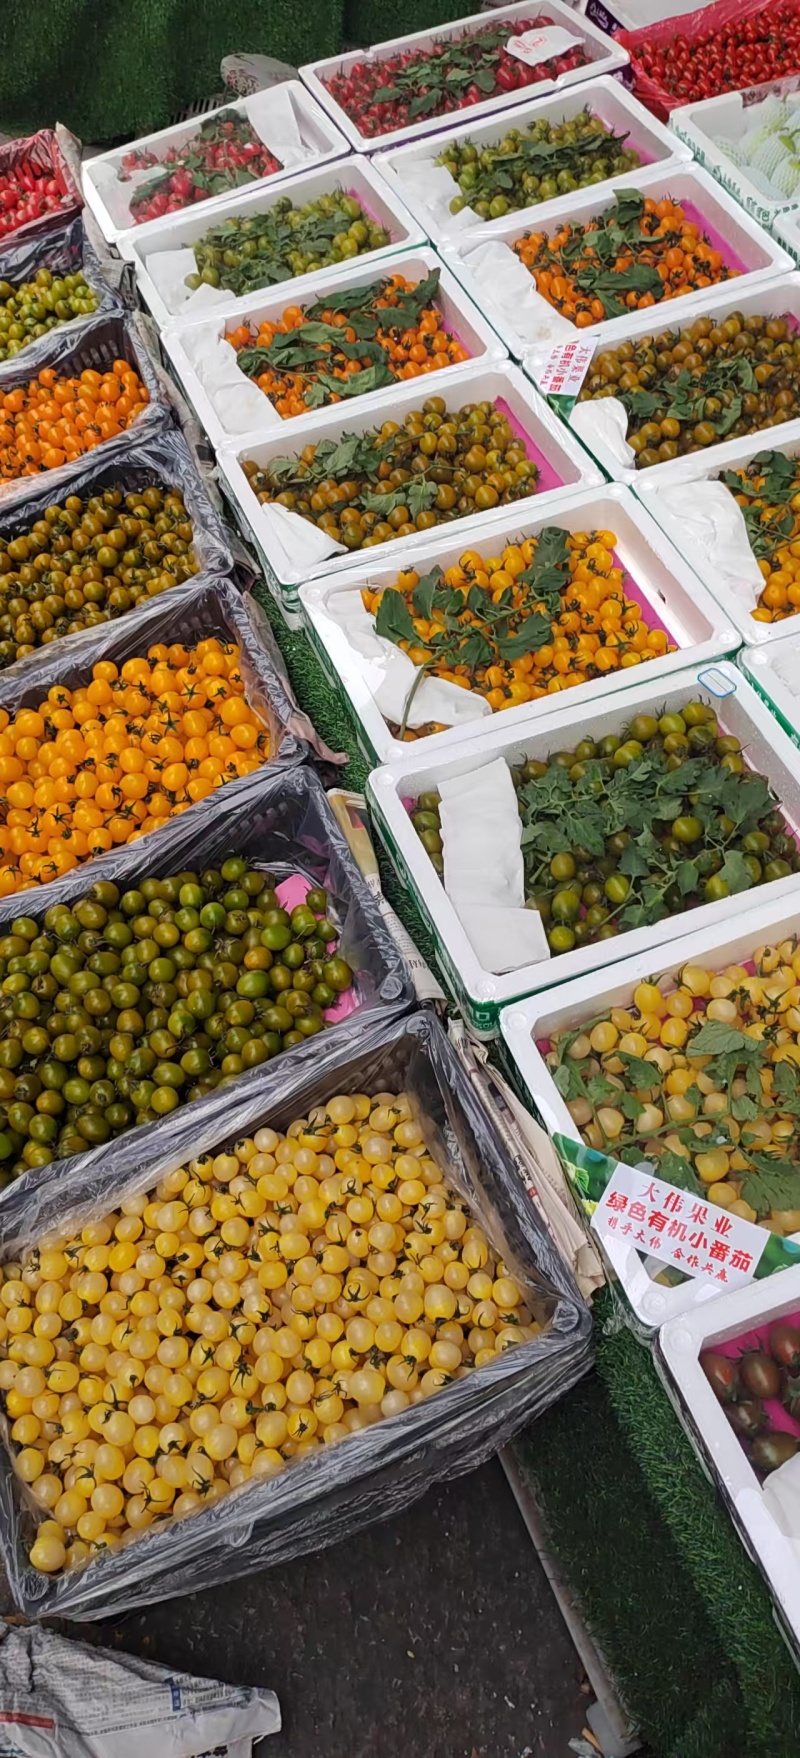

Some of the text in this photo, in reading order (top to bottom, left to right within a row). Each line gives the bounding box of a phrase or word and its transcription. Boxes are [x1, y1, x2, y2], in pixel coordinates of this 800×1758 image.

[549, 340, 580, 392] 色有机小番茄
[605, 1191, 753, 1273] 绿色有机小番茄
[637, 1182, 733, 1239] 大伟果业
[671, 1247, 728, 1283] 合作共赢
